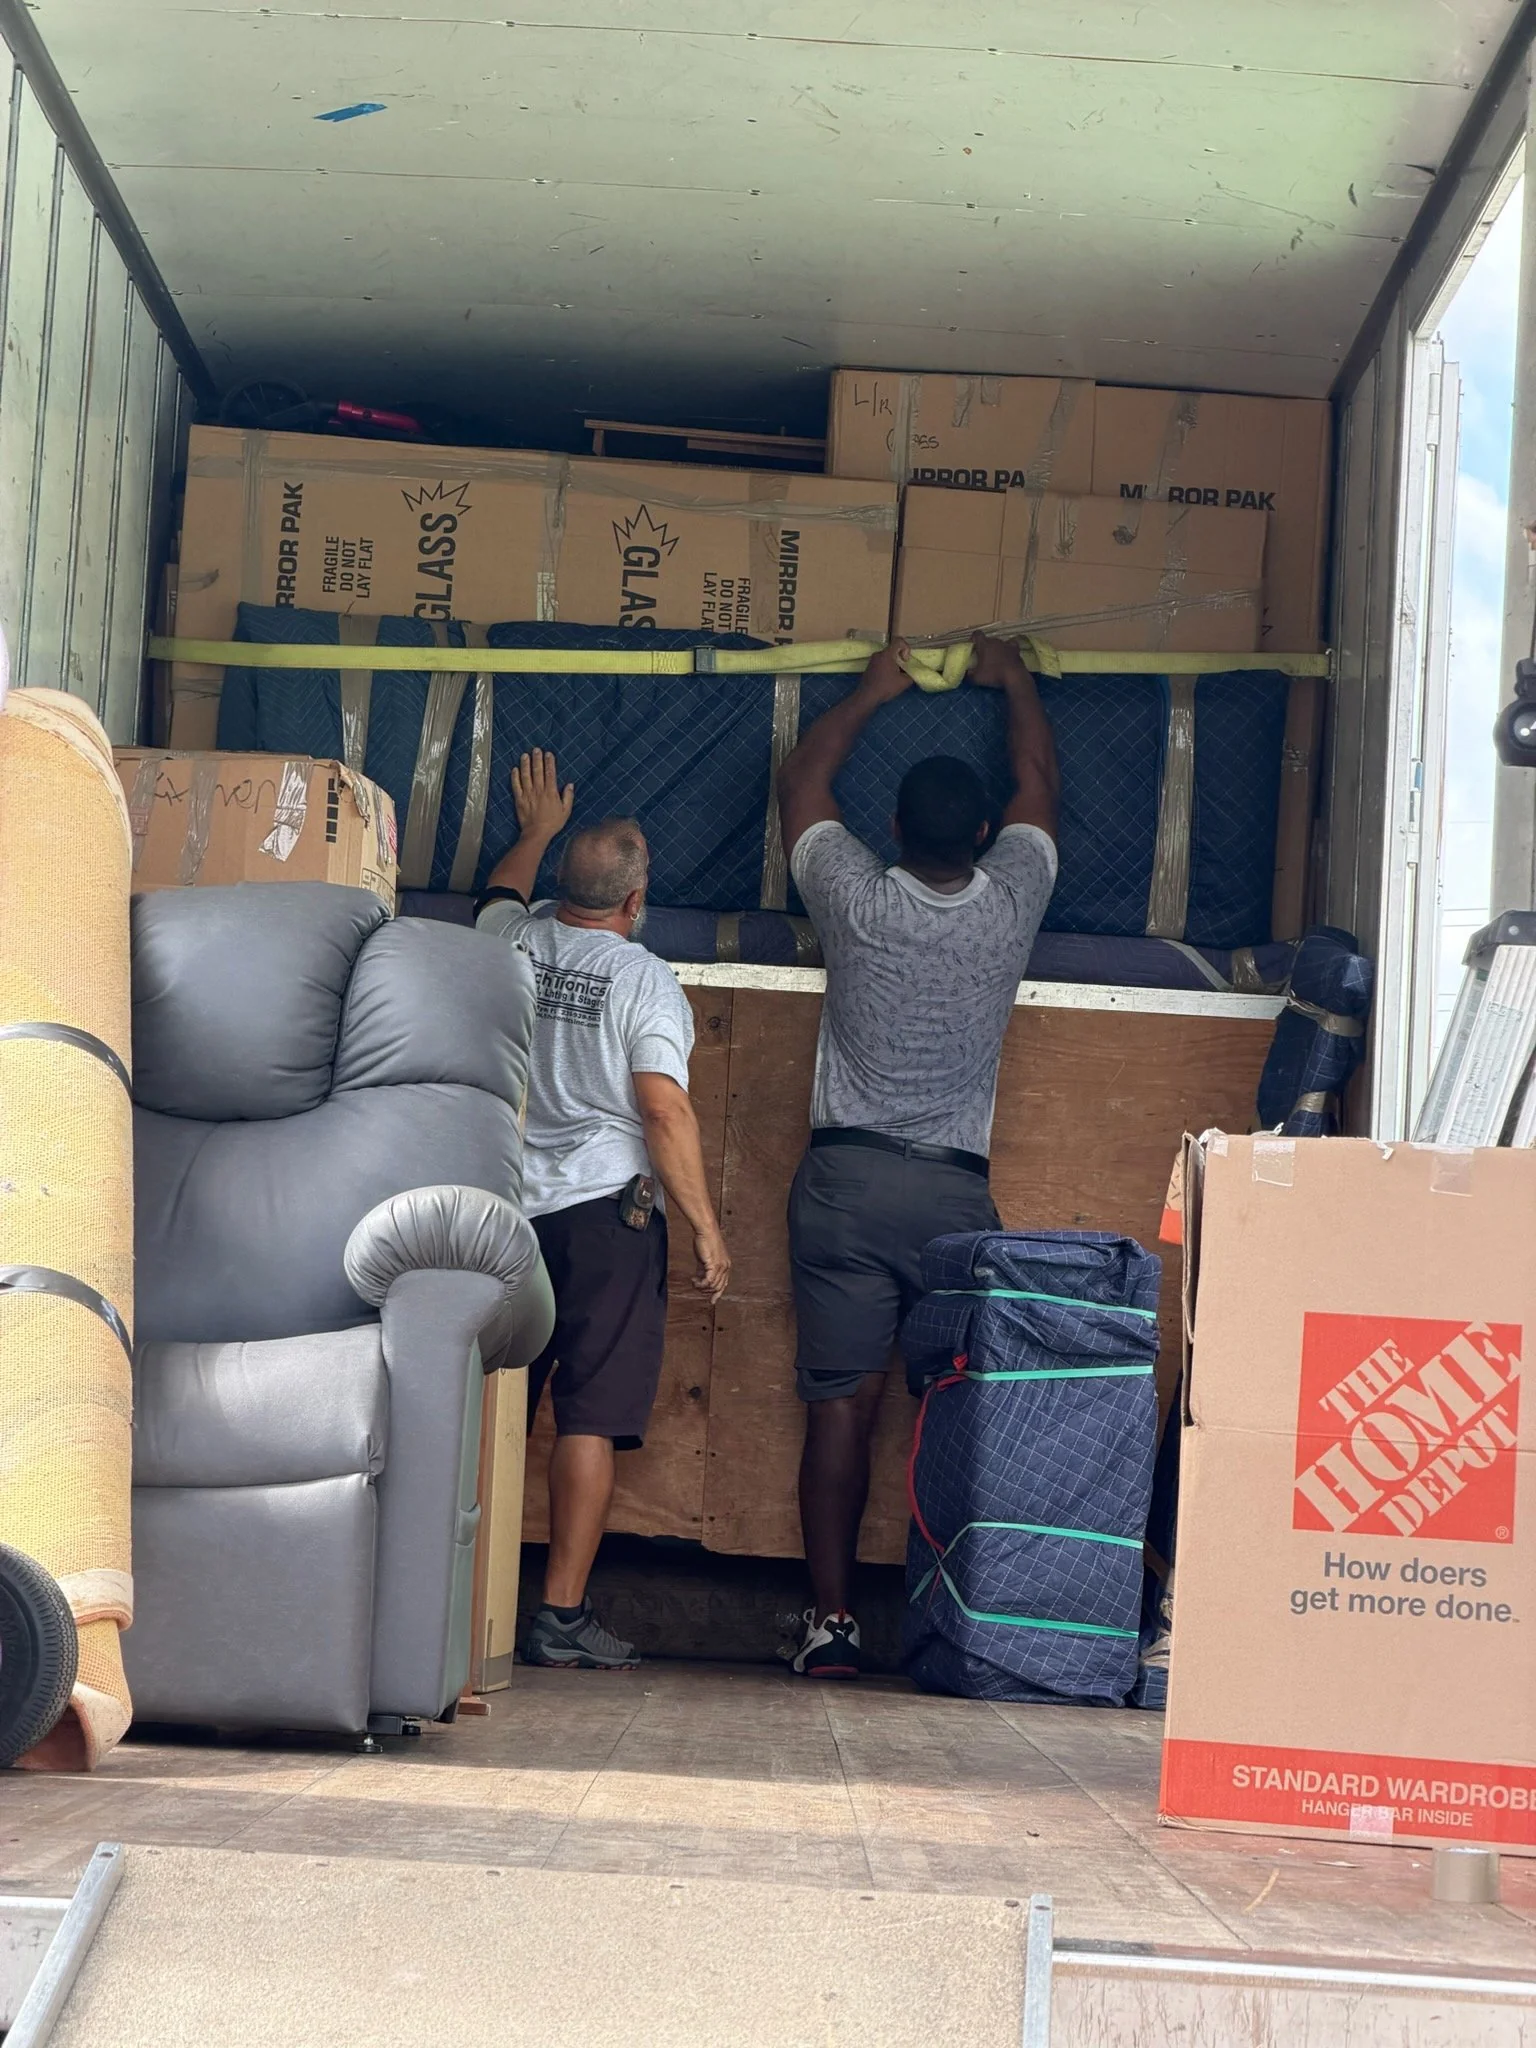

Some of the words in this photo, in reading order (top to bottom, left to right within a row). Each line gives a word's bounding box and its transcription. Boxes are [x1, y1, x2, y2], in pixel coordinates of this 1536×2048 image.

[281, 482, 303, 533] PAK
[1226, 489, 1276, 511] PAK
[323, 535, 339, 593] FRAGILE
[342, 540, 357, 570] NOT
[358, 537, 373, 570] FLAT
[413, 512, 458, 622] GLASS
[340, 571, 354, 591] DO
[356, 574, 371, 599] LAY
[703, 572, 717, 597] LAY
[719, 579, 734, 600] DO
[778, 530, 800, 631] MIRROR
[701, 601, 716, 632] FLAT
[718, 602, 733, 630] NOT
[735, 577, 751, 635] FRAGILE
[1318, 1338, 1415, 1424] THE
[1295, 1320, 1523, 1533] HOME
[1379, 1403, 1518, 1537] DEPOT
[1324, 1551, 1391, 1580] How
[1400, 1557, 1487, 1587] doers
[1290, 1587, 1340, 1615] get
[1348, 1593, 1426, 1617] more
[1232, 1765, 1379, 1798] STANDARD
[1302, 1799, 1373, 1818] HANGER
[1377, 1805, 1414, 1822] BAR
[1418, 1808, 1473, 1827] INSIDE
